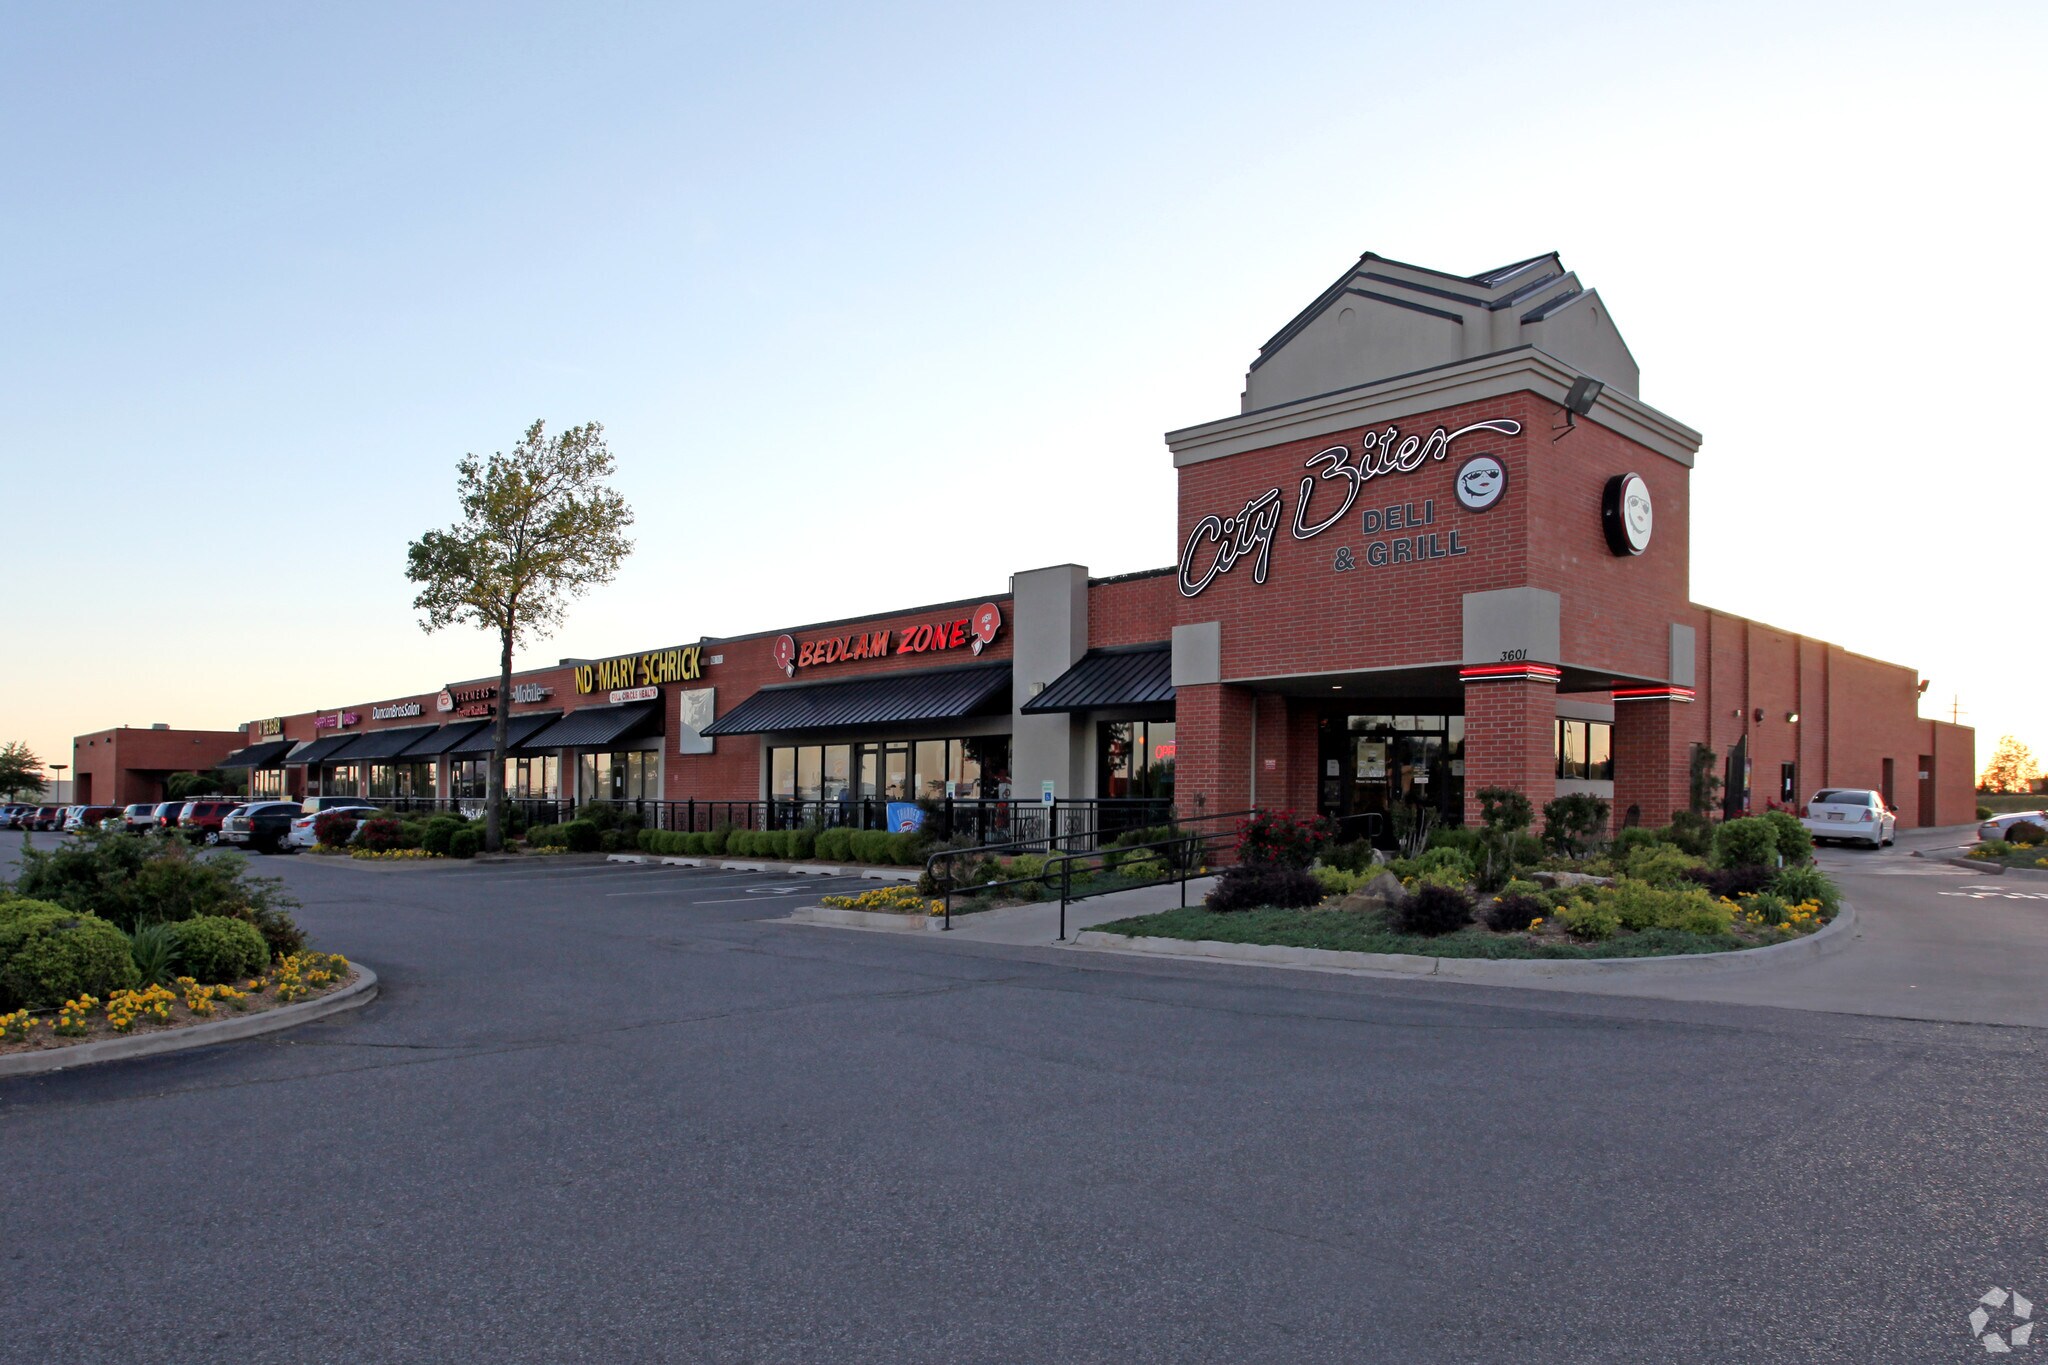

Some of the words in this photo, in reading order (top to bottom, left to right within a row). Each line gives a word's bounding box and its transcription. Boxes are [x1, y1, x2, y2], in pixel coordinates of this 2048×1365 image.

[1178, 487, 1284, 598] City
[1292, 418, 1523, 541] Bites
[1361, 499, 1435, 535] DELI
[1333, 546, 1356, 573] &
[1367, 529, 1467, 566] GRILL
[798, 629, 893, 668] BEDLAM
[896, 618, 970, 655] ZONE
[1499, 648, 1528, 662] 3601
[574, 665, 594, 695] ND
[598, 656, 638, 691] MARY
[642, 646, 702, 686] SCHRICK
[456, 688, 490, 704] FARMERS
[514, 683, 543, 704] Mobile
[611, 691, 623, 702] FULL
[622, 689, 639, 701] CIRCLE
[639, 687, 657, 699] HEALTH
[372, 702, 421, 720] DuncanBrosSalon
[1155, 745, 1176, 759] OPE
[896, 807, 920, 823] THUNDER
